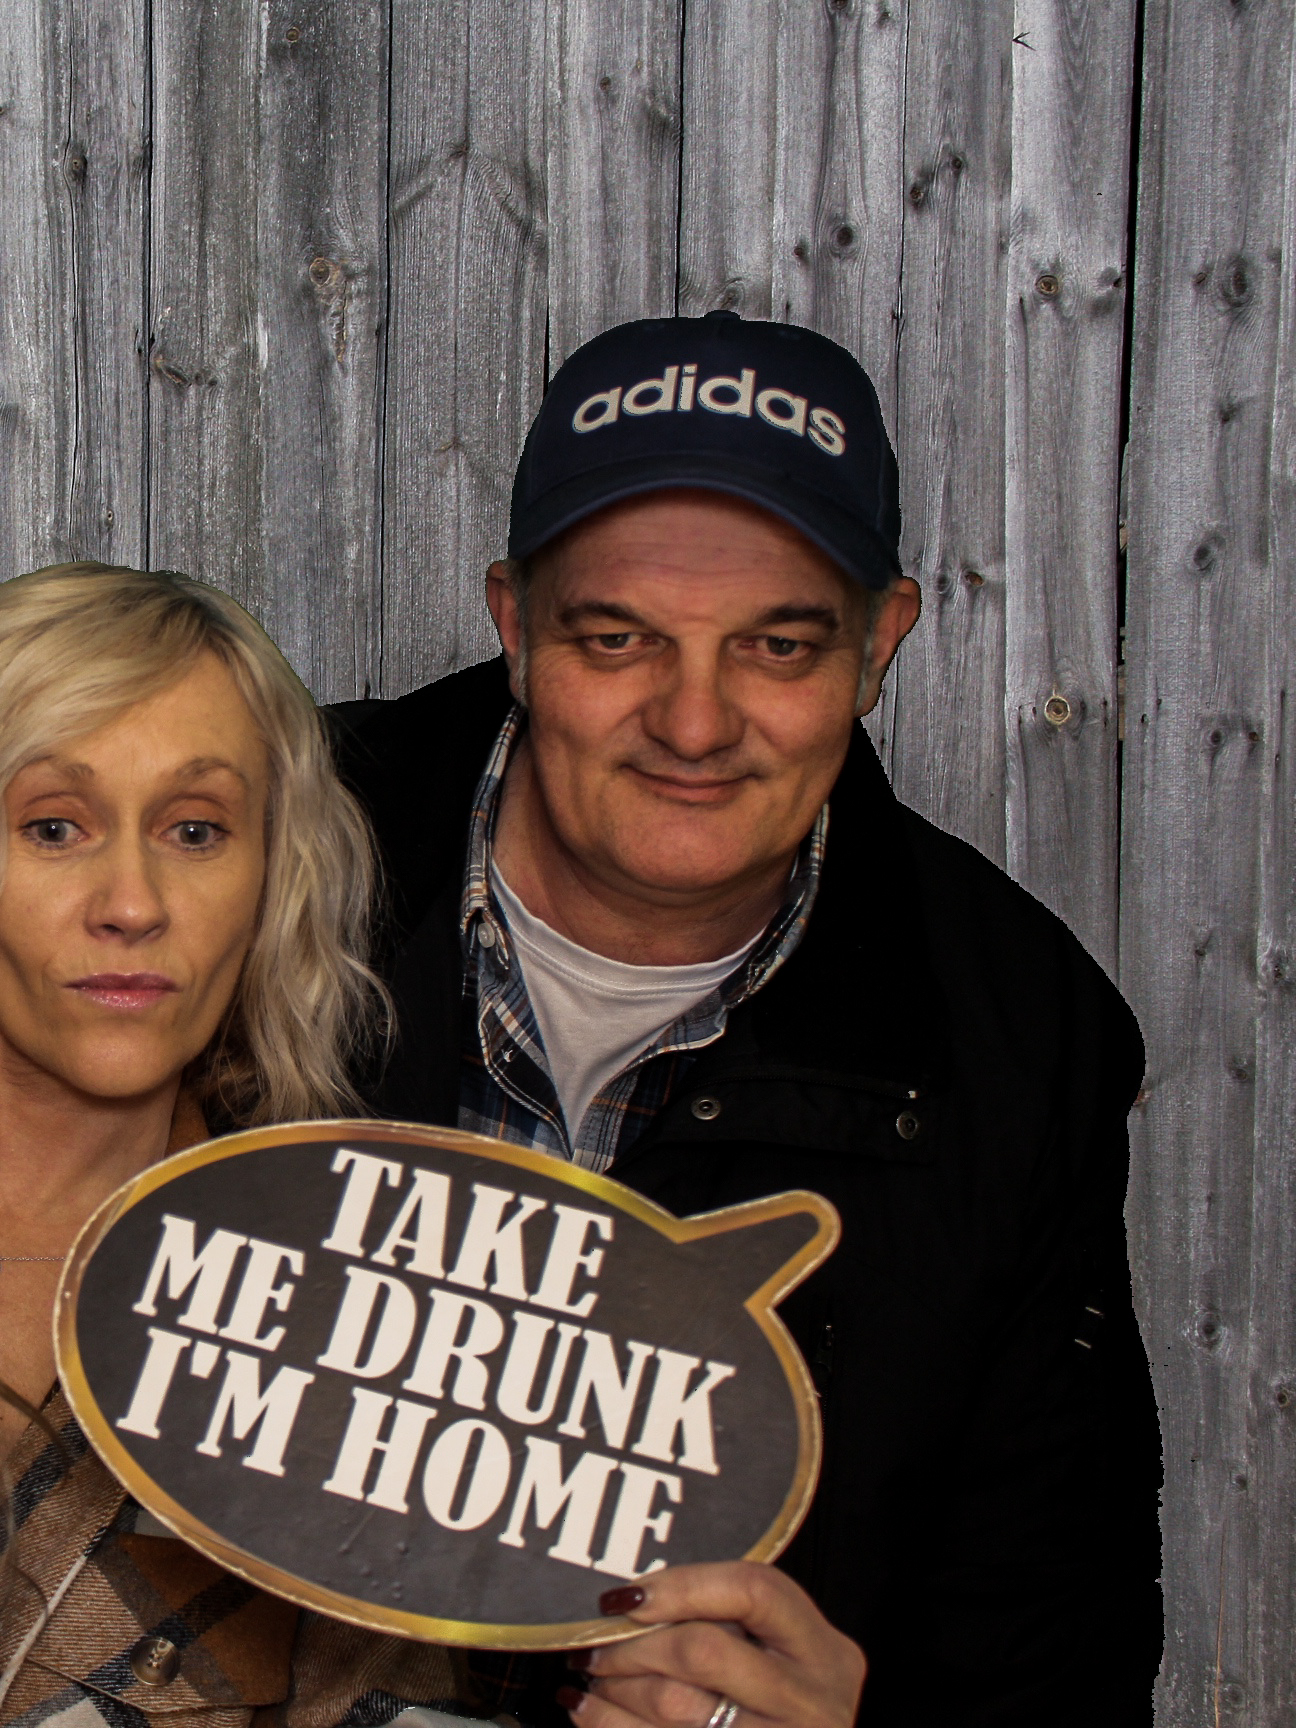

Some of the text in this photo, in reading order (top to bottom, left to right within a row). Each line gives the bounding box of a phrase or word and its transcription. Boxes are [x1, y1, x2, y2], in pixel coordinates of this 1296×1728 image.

[572, 363, 846, 457] adidas
[322, 1147, 614, 1318] TAKE
[132, 1213, 736, 1475] ME DRUNK
[116, 1326, 683, 1580] I'M HOME
